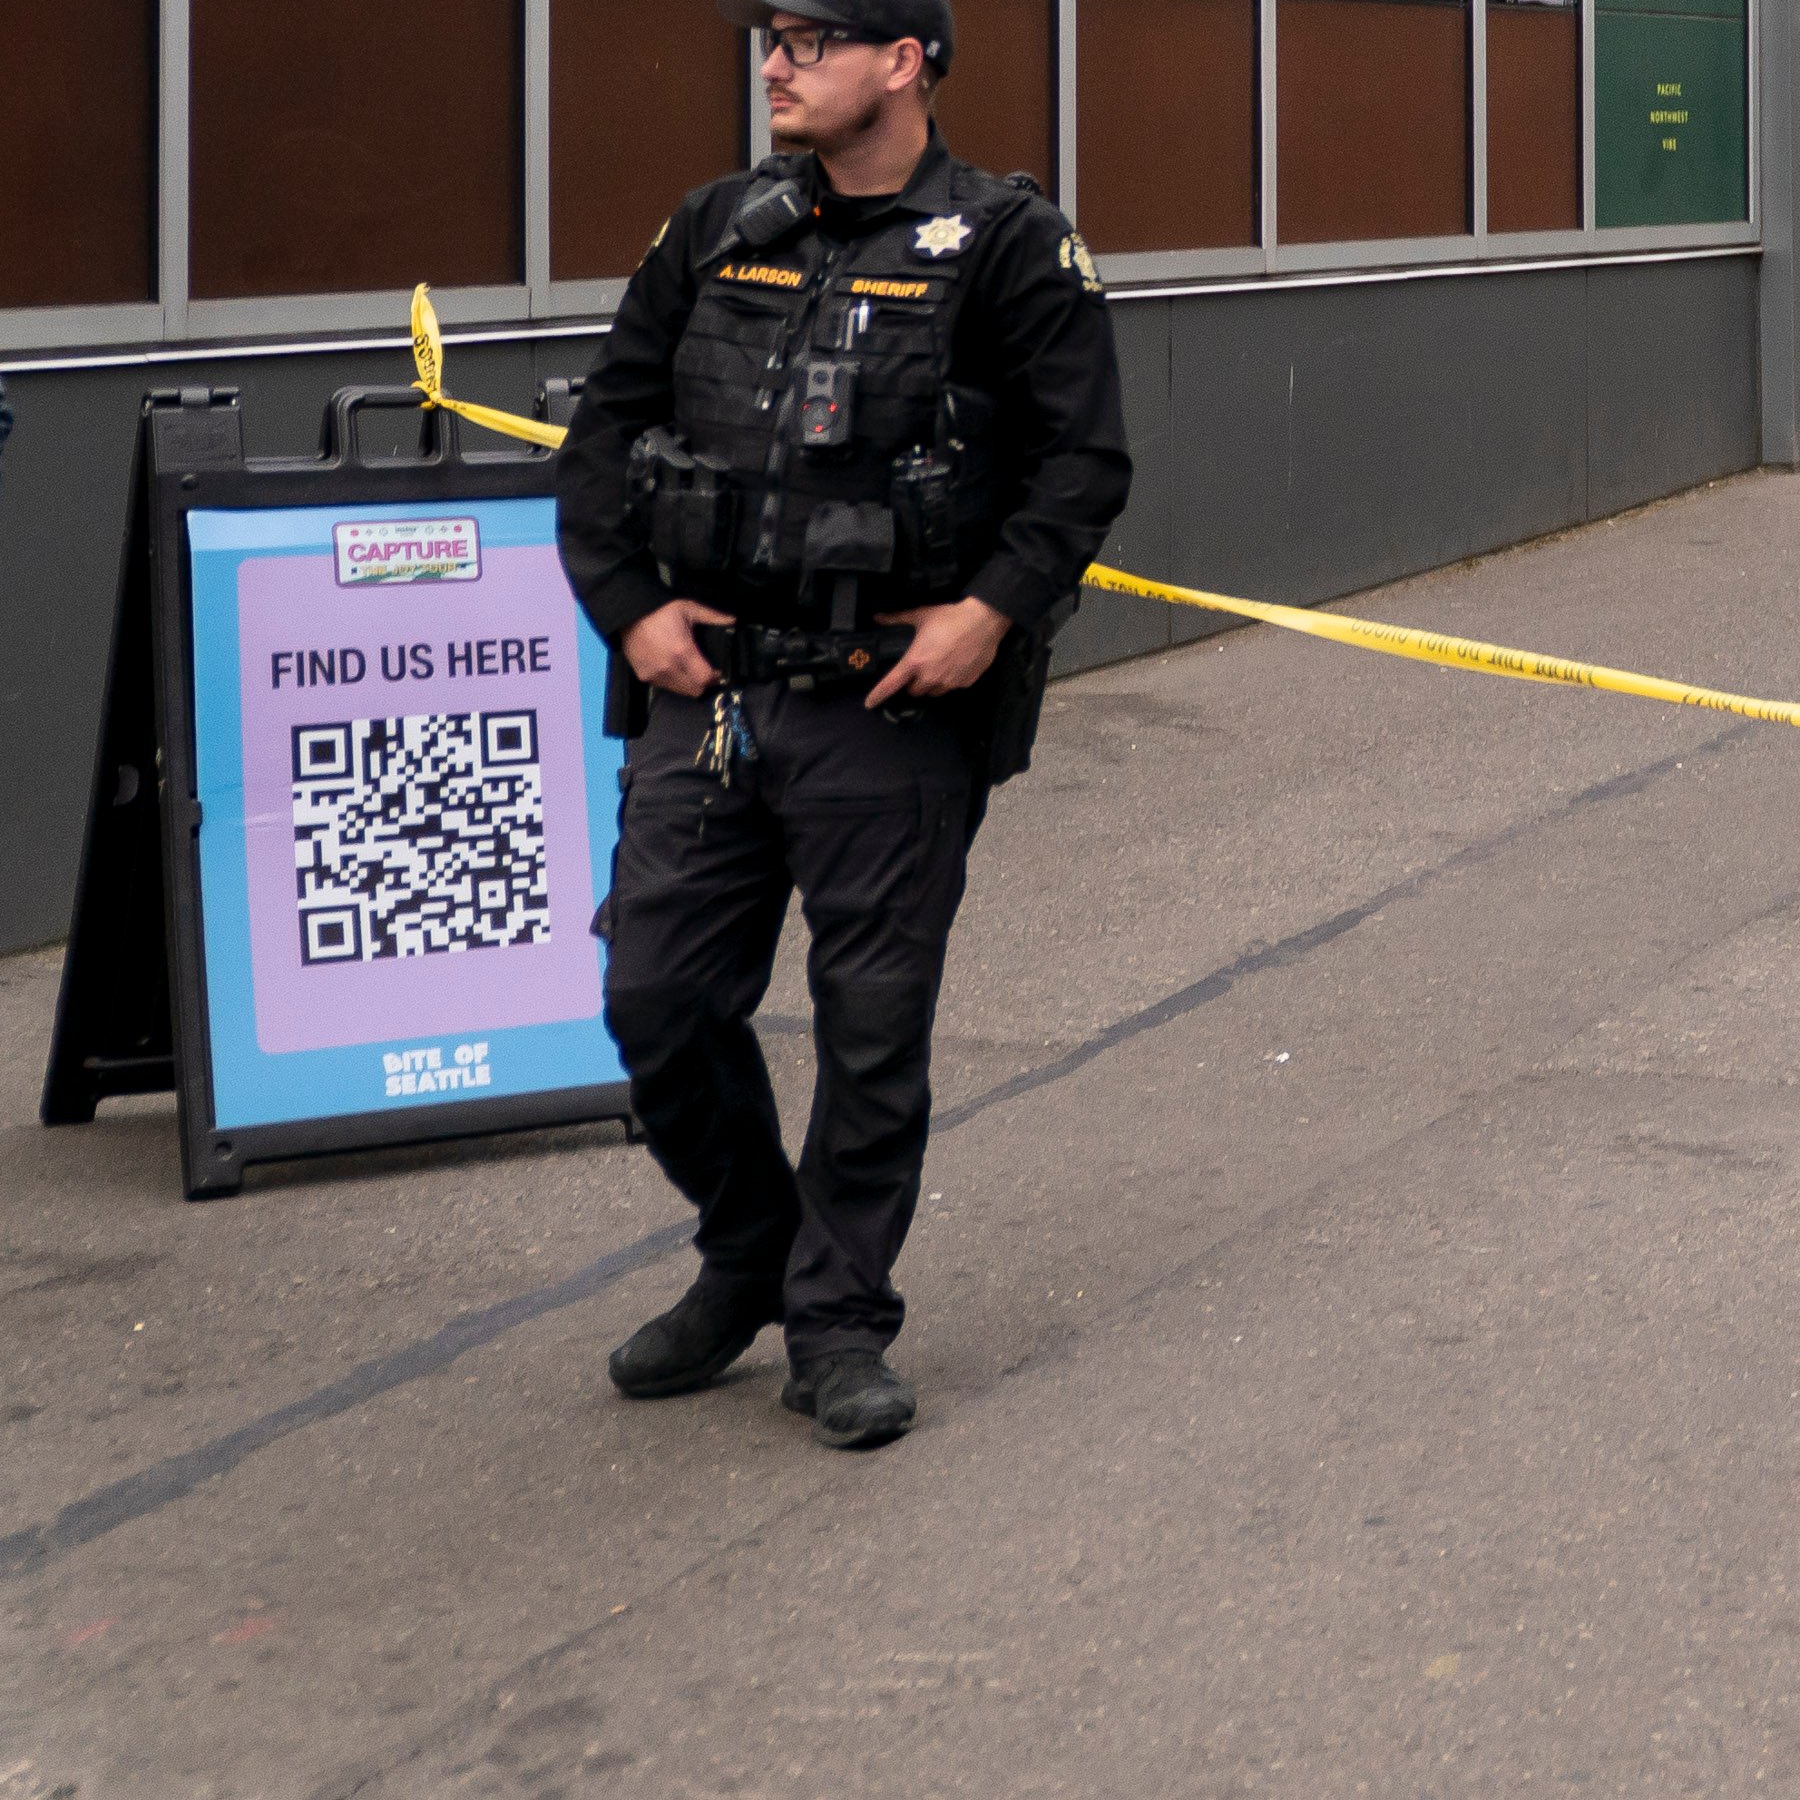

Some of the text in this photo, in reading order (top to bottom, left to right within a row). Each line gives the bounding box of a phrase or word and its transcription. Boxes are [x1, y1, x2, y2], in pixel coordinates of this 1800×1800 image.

[1656, 83, 1682, 97] PACIFIC
[1649, 111, 1689, 124] NORTHWEST
[719, 264, 802, 288] A. LARSON
[851, 279, 929, 298] SHERIFF
[347, 539, 469, 563] CAPTURE
[271, 636, 552, 689] FIND US HERE
[382, 1042, 489, 1075] BITE OF
[385, 1063, 492, 1097] SEATTLE
